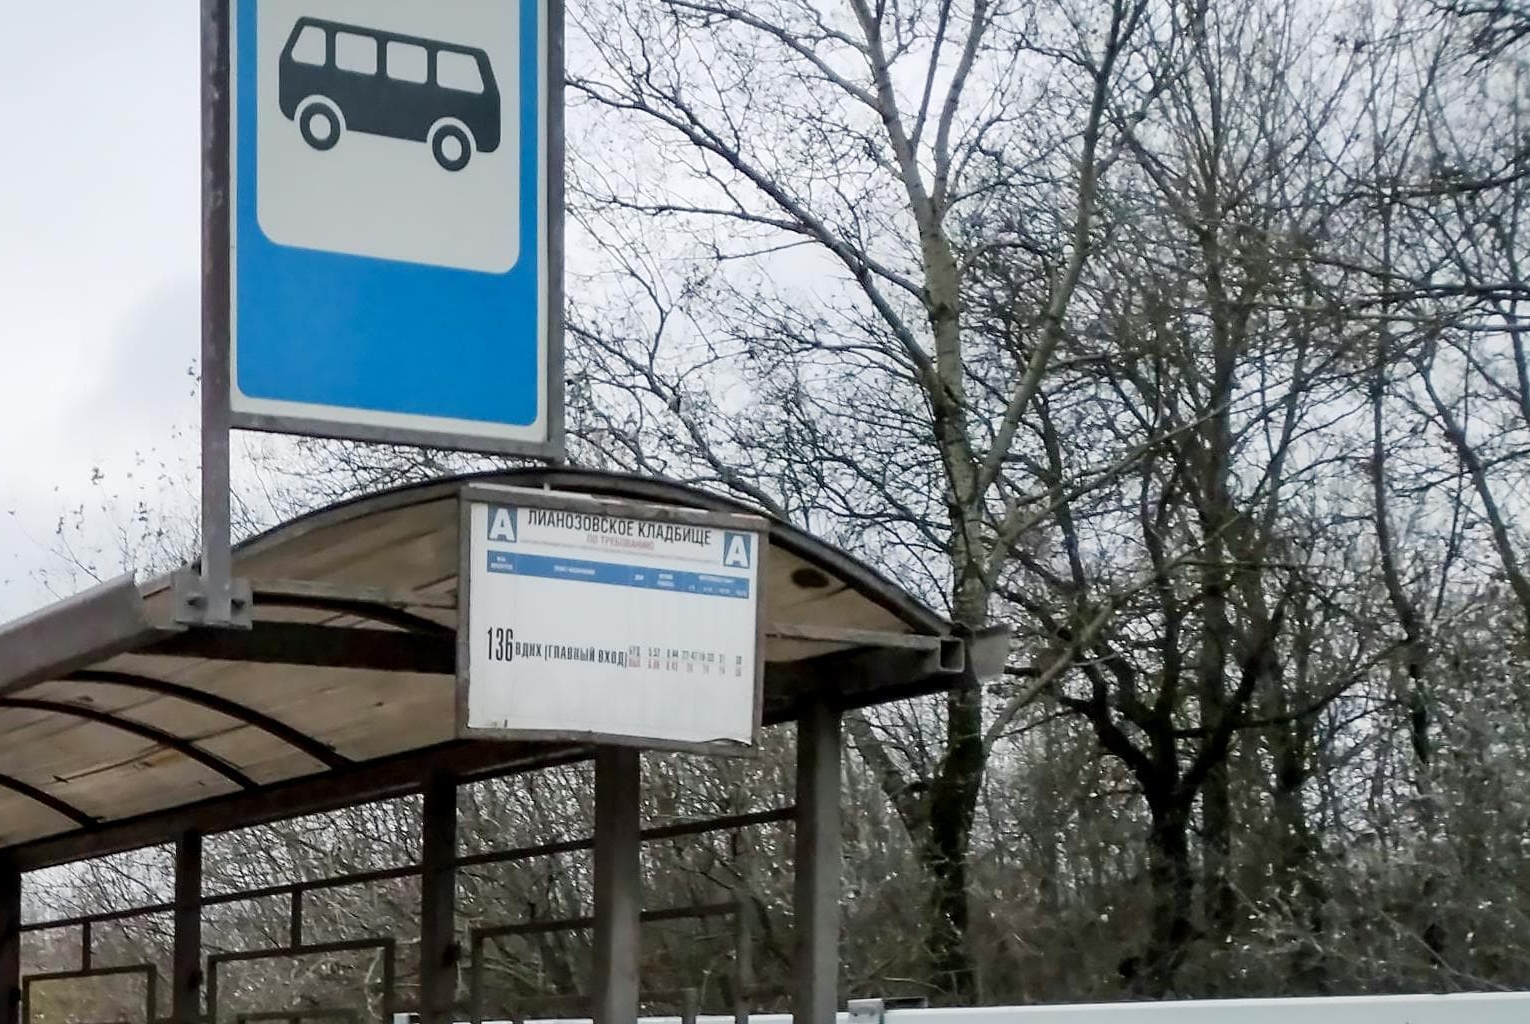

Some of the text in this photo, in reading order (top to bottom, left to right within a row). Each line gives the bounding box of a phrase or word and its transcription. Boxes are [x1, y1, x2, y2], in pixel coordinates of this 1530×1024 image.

[488, 507, 516, 542] А
[528, 509, 712, 547] ЛИАНОЗОВСКОЕ КЛАДБИЩЕ
[724, 534, 750, 568] А
[488, 627, 514, 662] 136
[515, 641, 542, 659] ВДНХ
[544, 643, 596, 663] (ГЛАВНЫЙ
[598, 649, 629, 668] ВХОД)
